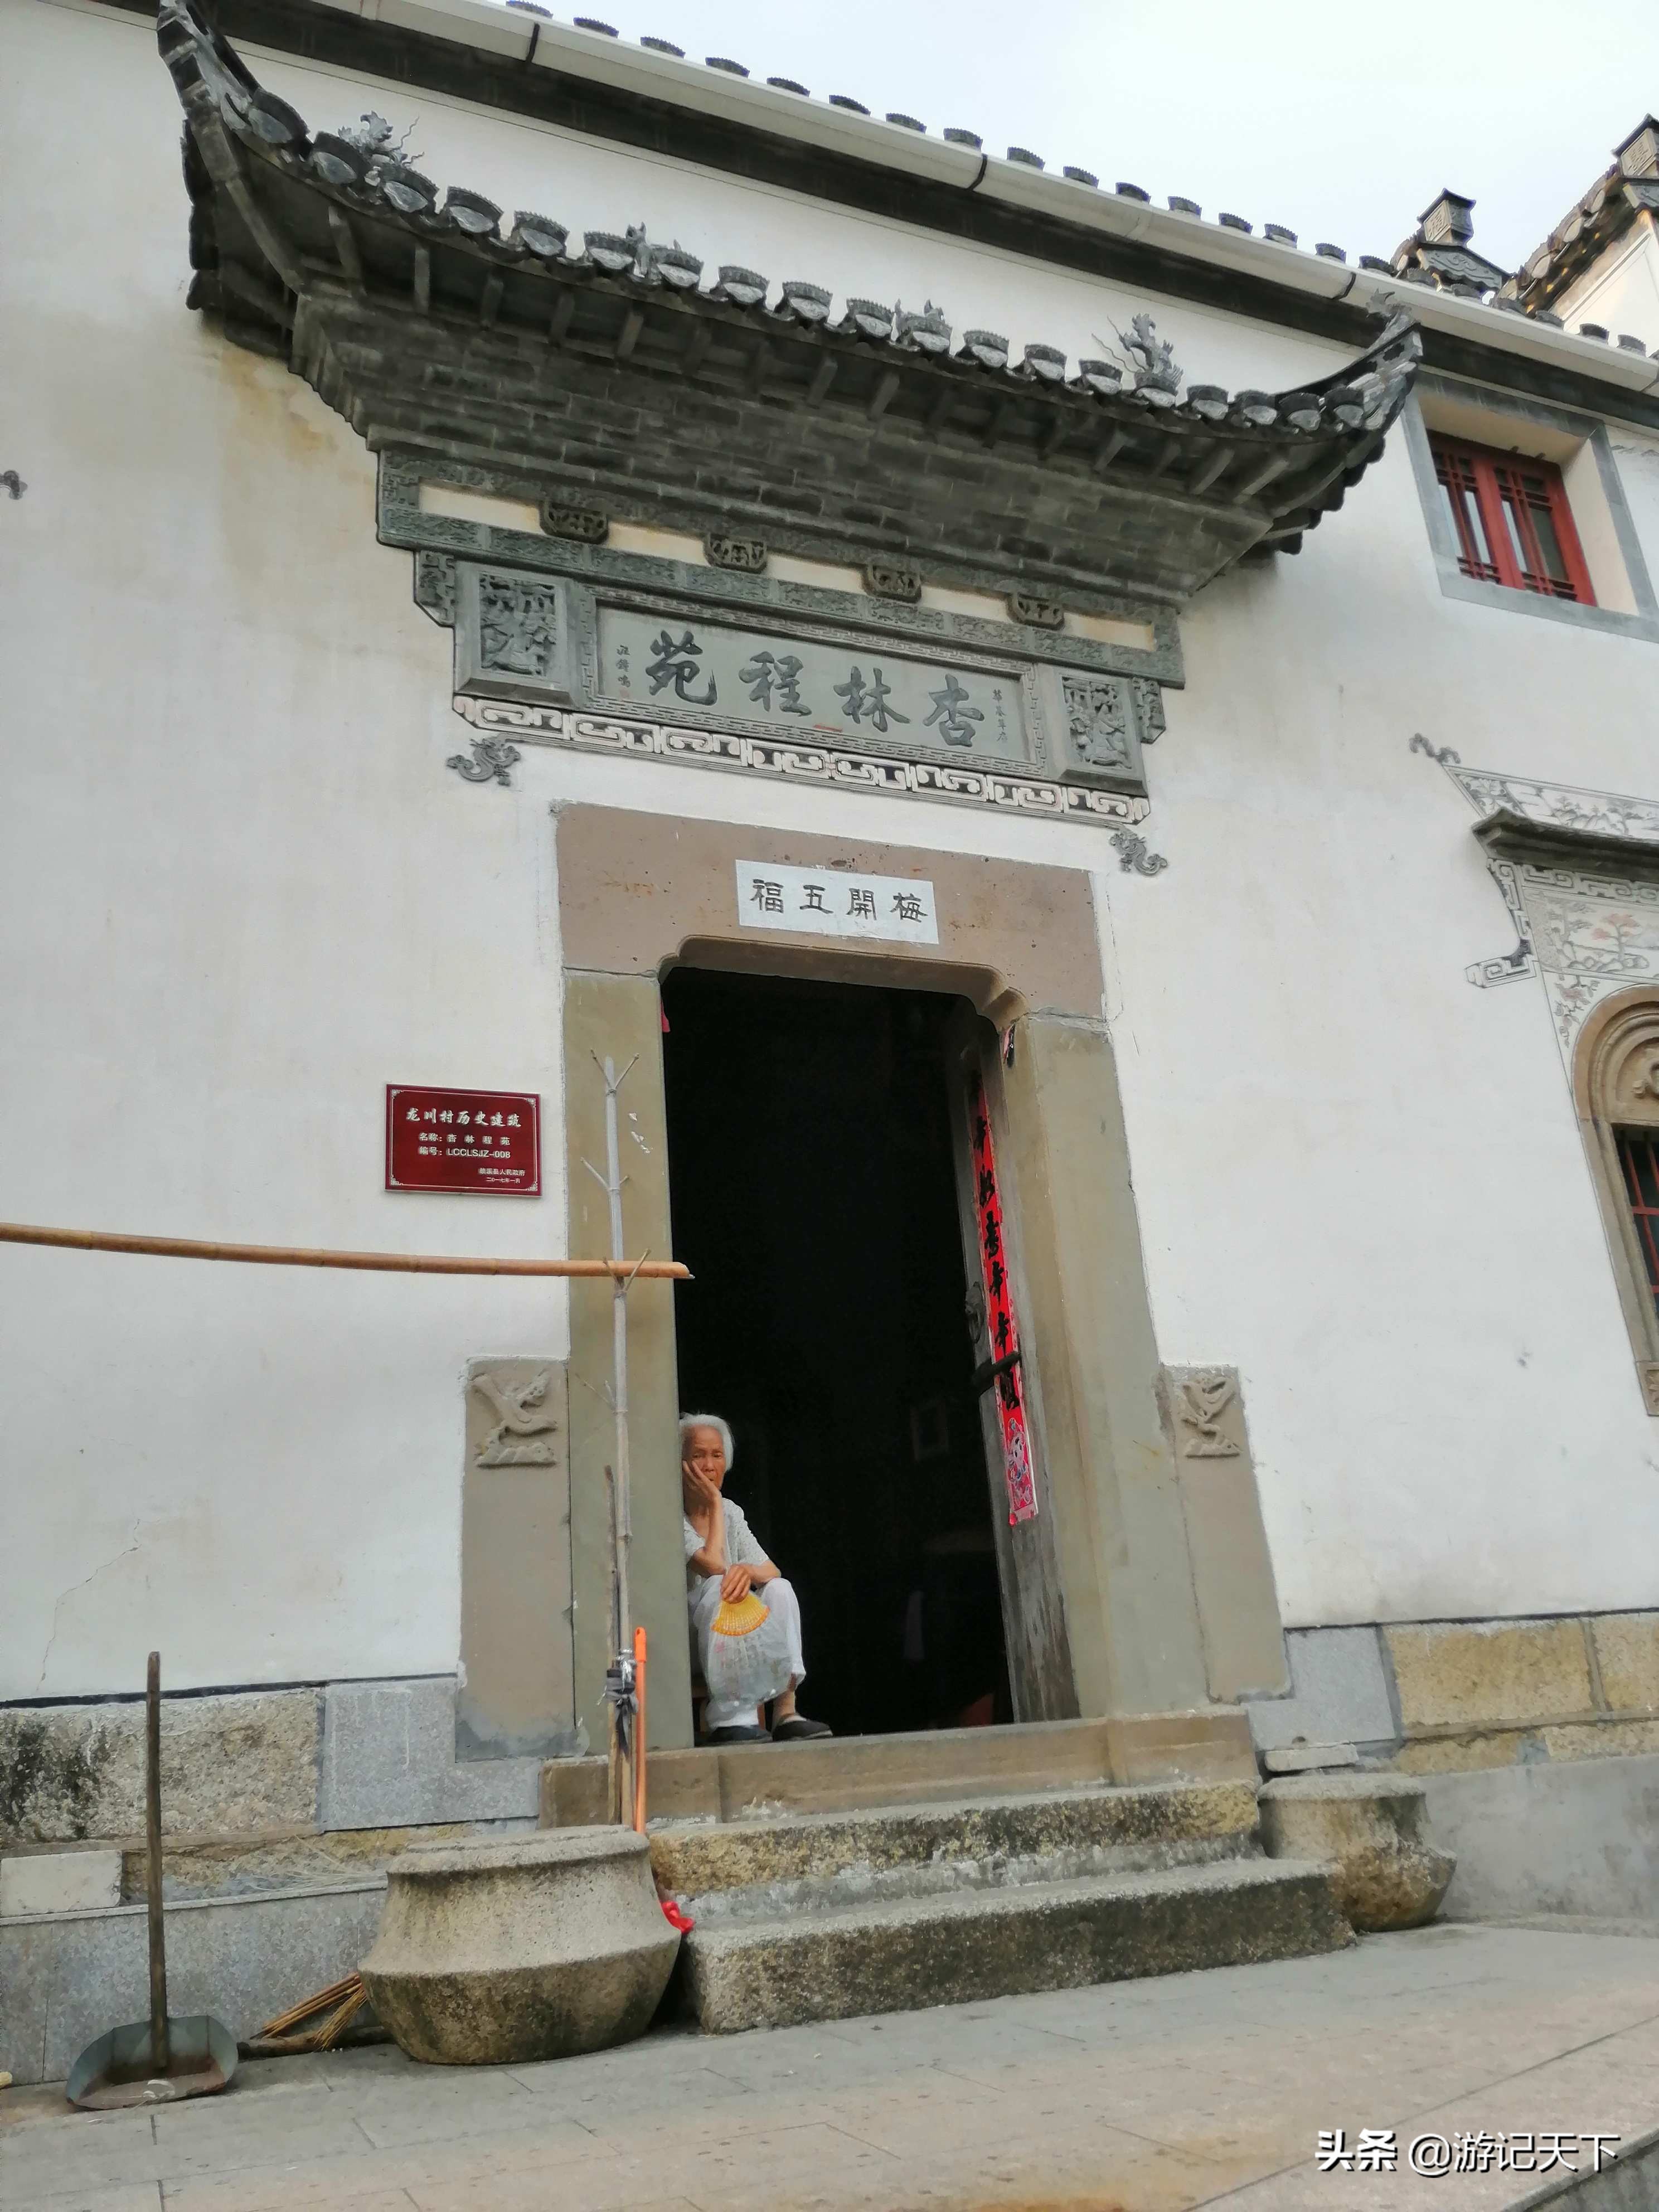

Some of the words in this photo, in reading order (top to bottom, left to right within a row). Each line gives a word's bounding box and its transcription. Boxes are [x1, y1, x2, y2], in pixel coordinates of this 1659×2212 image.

[645, 630, 985, 748] 杏林程苑
[406, 1107, 522, 1127] 龙川村历史建筑
